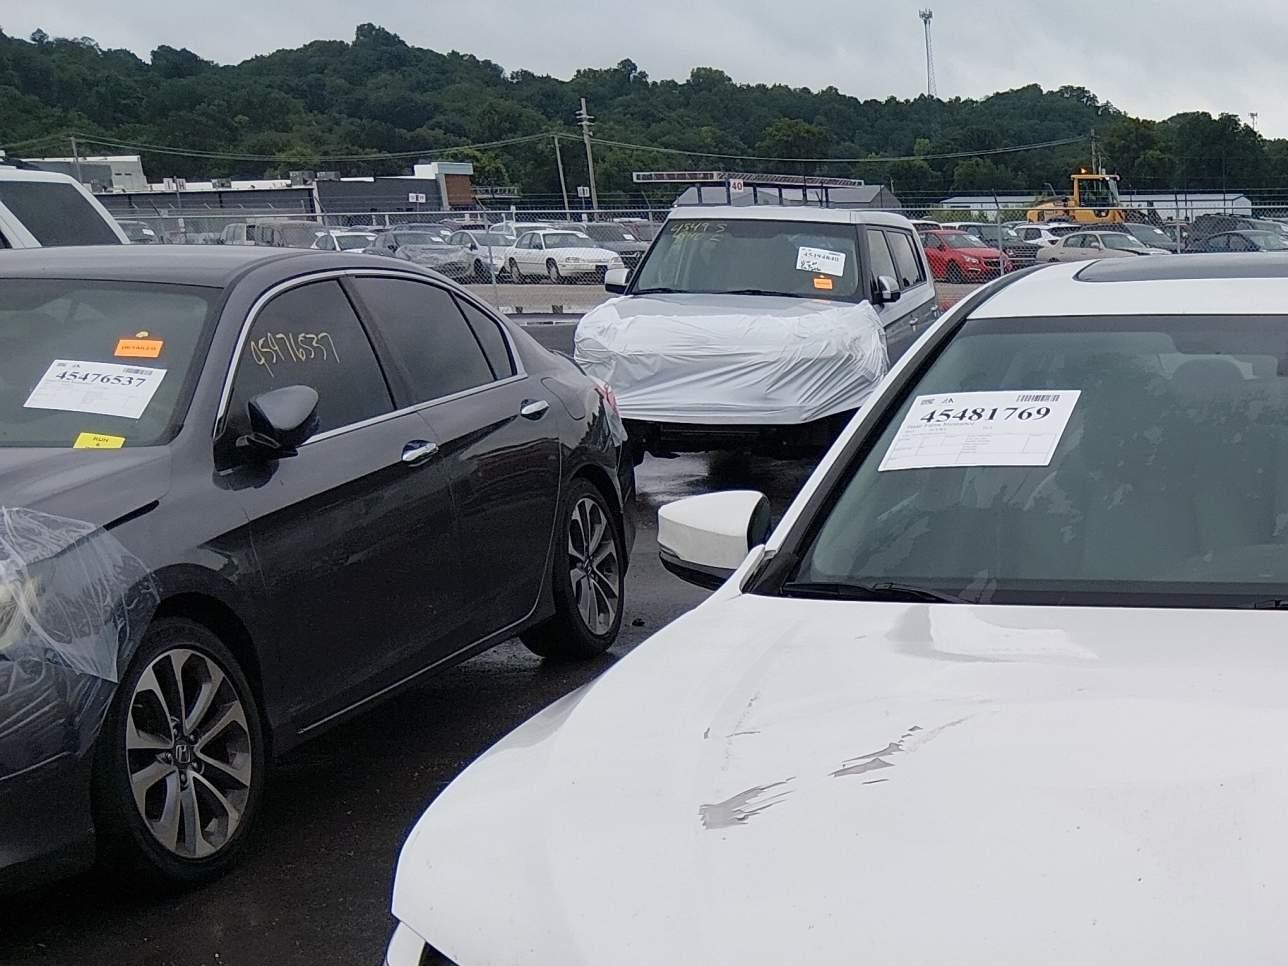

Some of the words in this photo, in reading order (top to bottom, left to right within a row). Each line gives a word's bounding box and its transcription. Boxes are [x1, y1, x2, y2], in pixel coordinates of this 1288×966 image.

[732, 181, 743, 191] 40
[55, 369, 147, 388] 45476537
[919, 406, 1051, 423] 45481769
